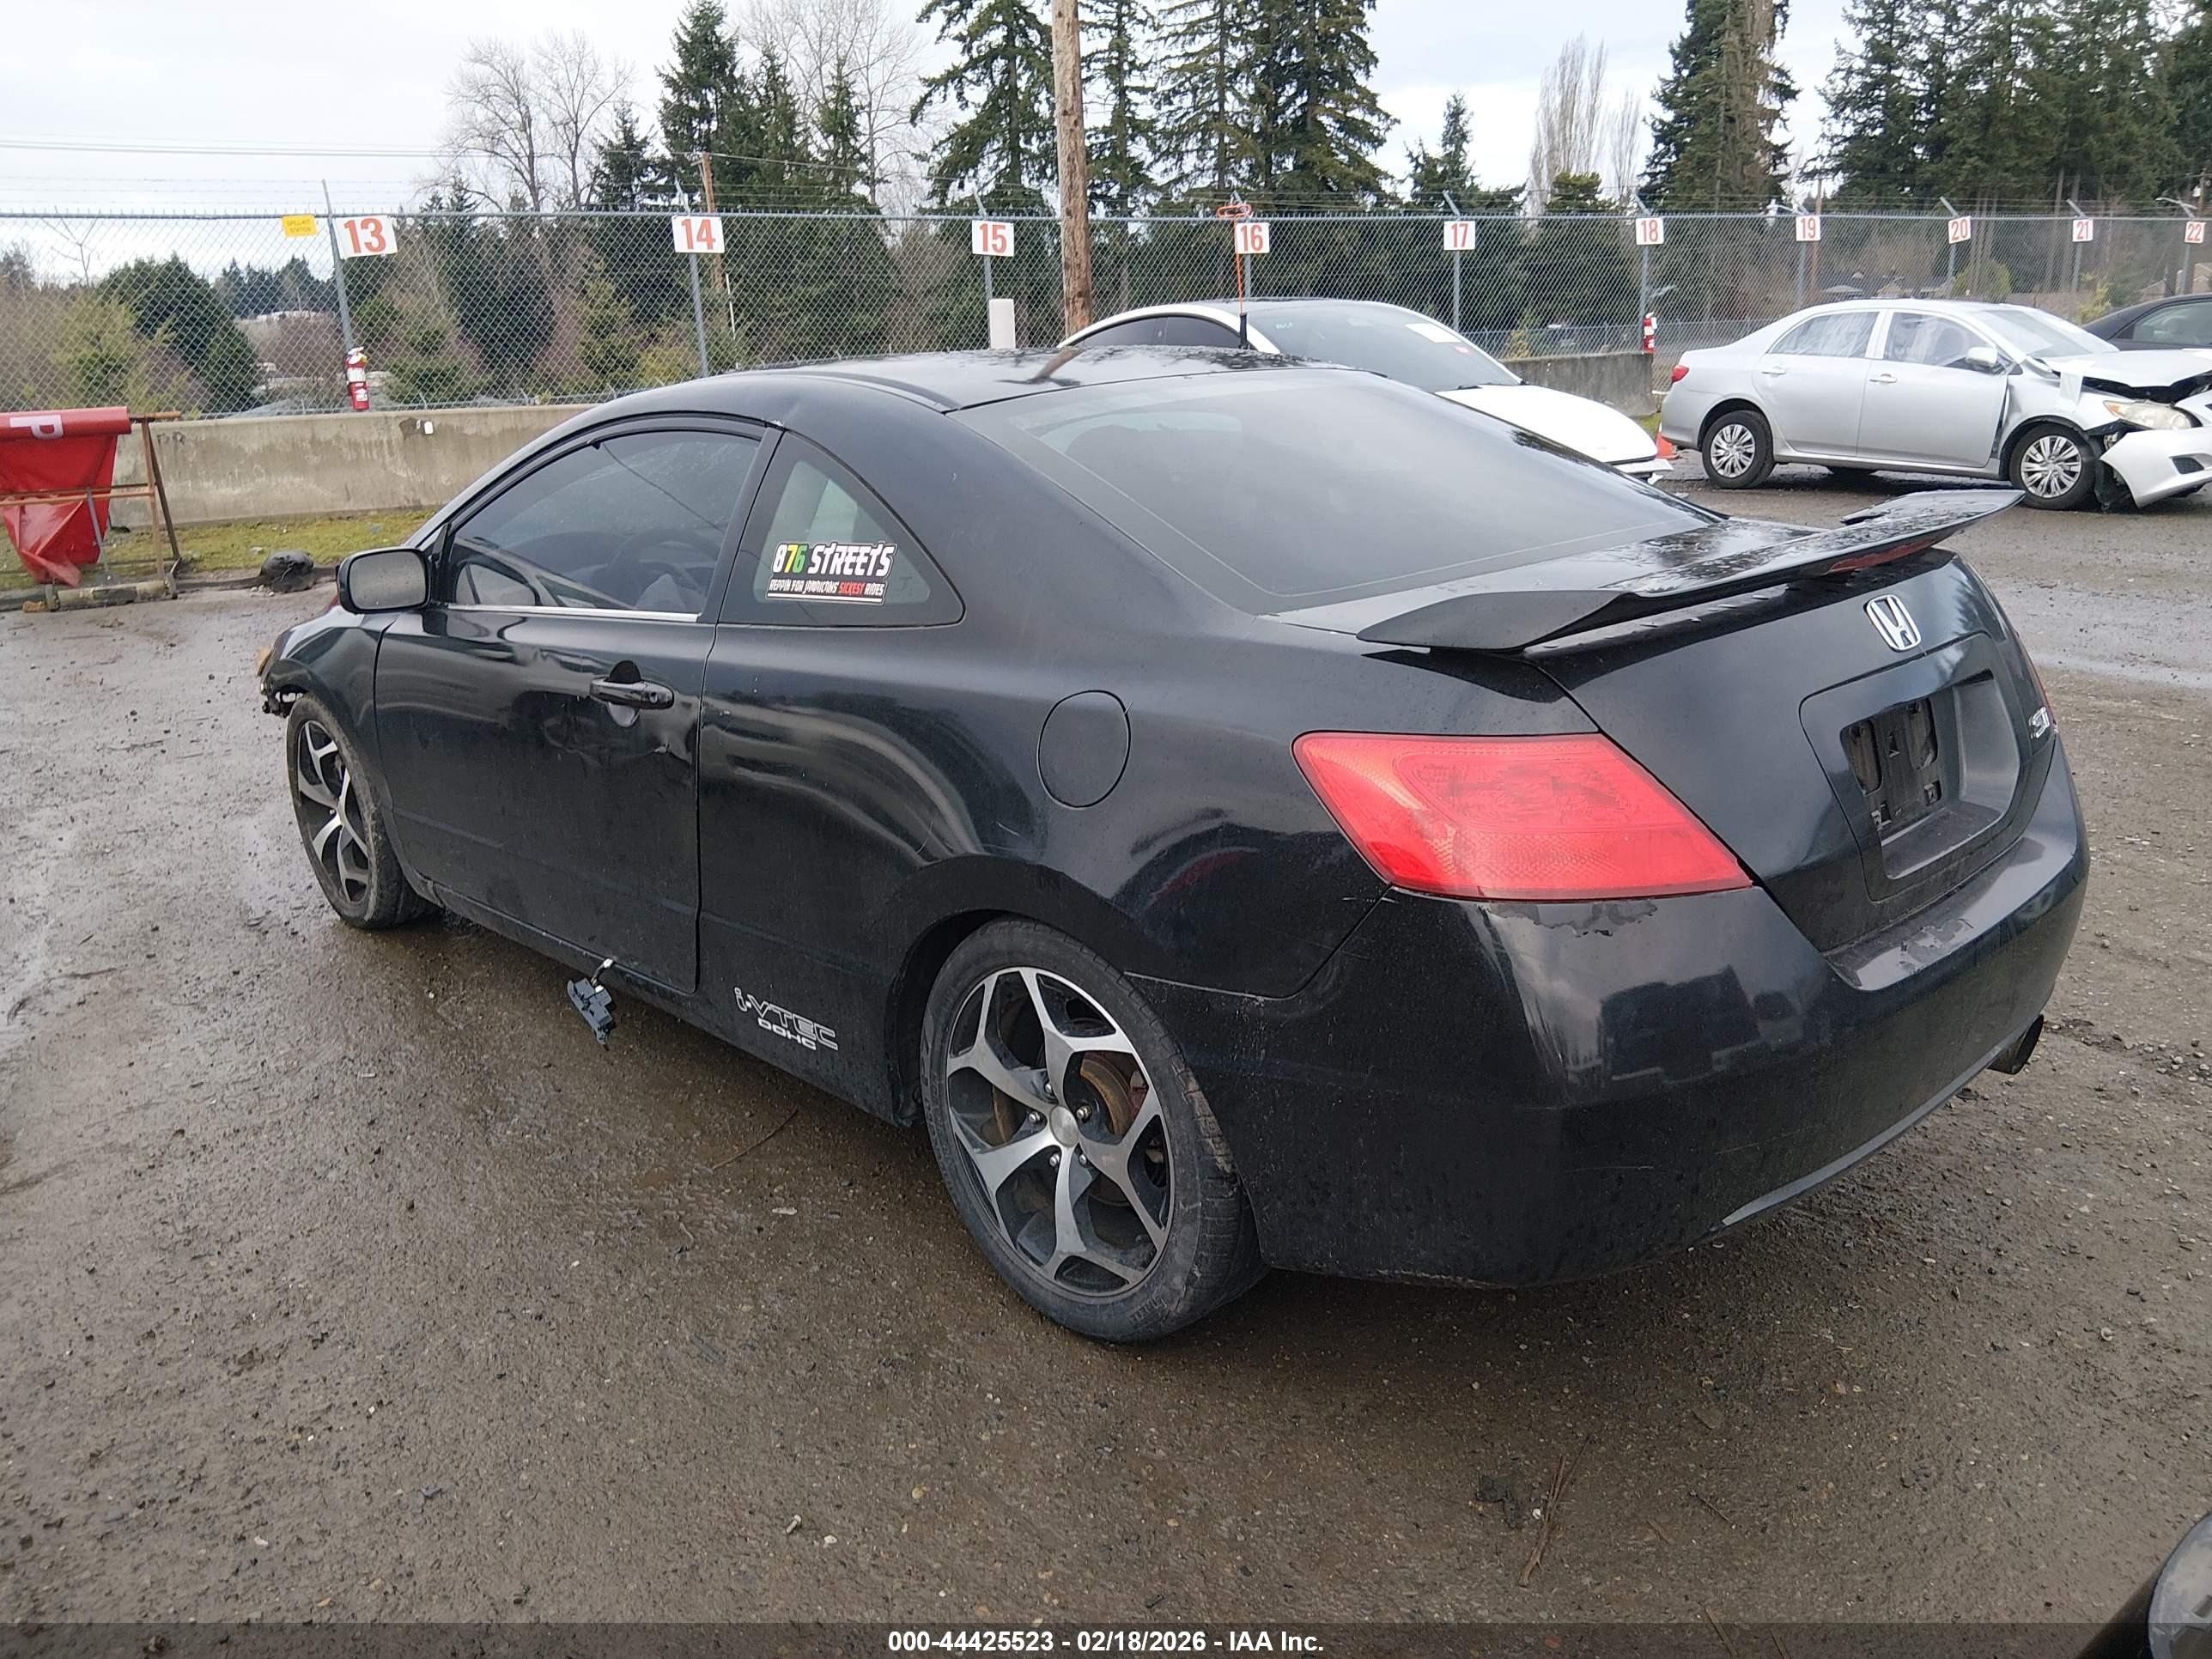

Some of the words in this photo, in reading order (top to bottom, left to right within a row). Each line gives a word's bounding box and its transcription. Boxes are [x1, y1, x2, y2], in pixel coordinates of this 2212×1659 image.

[343, 216, 386, 254] 13
[682, 218, 715, 250] 14
[980, 223, 1007, 254] 15
[1241, 224, 1263, 252] 16
[1451, 223, 1468, 248] 17
[1641, 220, 1658, 242] 18
[1801, 218, 1816, 240] 19
[1951, 219, 1967, 241] 20
[2076, 222, 2089, 240] 21
[2186, 223, 2202, 241] 22
[773, 544, 807, 574] 876
[807, 543, 895, 577] STREETS
[791, 580, 805, 592] FOR
[838, 581, 866, 596] SICKEST
[864, 582, 885, 597] RIDES
[757, 1018, 817, 1050] DOHC
